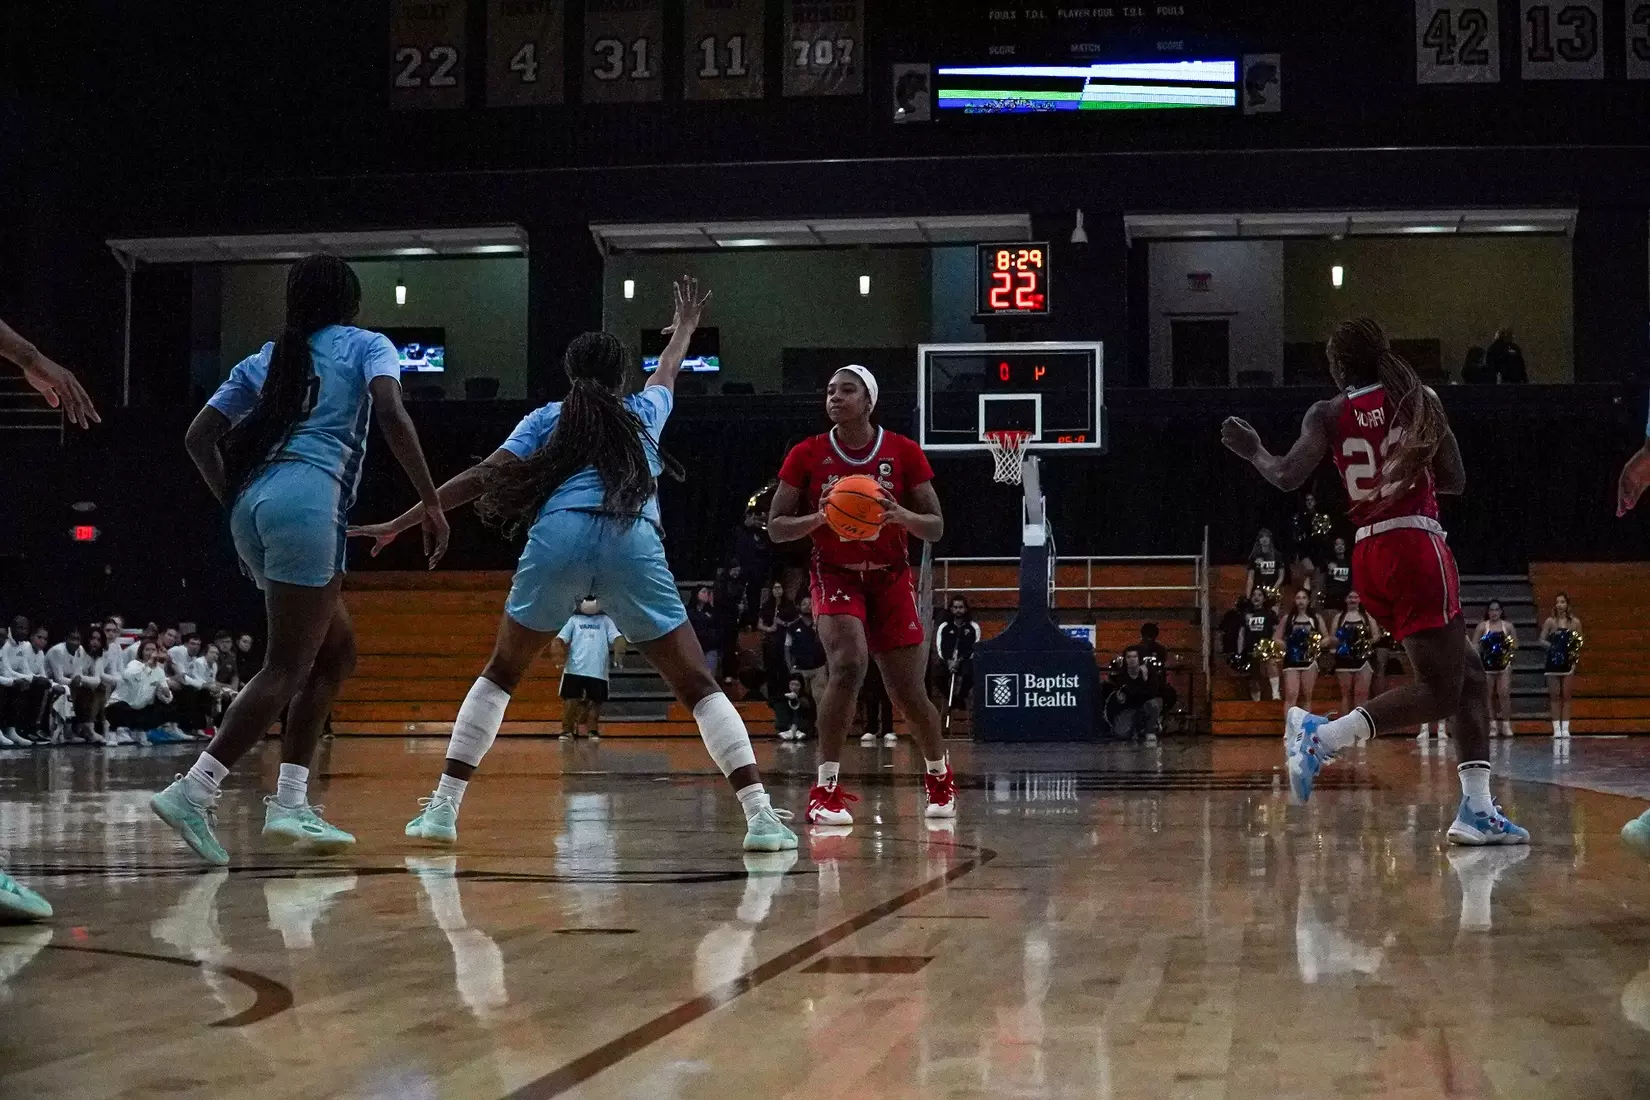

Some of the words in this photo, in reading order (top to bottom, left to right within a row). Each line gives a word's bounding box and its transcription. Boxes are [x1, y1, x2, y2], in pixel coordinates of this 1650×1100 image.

[988, 10, 1016, 20] FOULS
[1156, 5, 1185, 17] FOULS
[988, 44, 1016, 55] SCORE
[1070, 43, 1101, 52] MATCH
[1156, 40, 1184, 51] SCORE
[1423, 9, 1489, 65] 42
[1526, 5, 1598, 62] 13
[394, 46, 459, 88] 22
[510, 42, 539, 82] 4
[592, 38, 651, 80] 31
[698, 35, 747, 78] 11
[792, 38, 855, 67] 707
[997, 250, 1042, 270] 8:29
[990, 272, 1036, 308] 22
[1023, 673, 1080, 692] Baptist
[1023, 691, 1077, 708] Health
